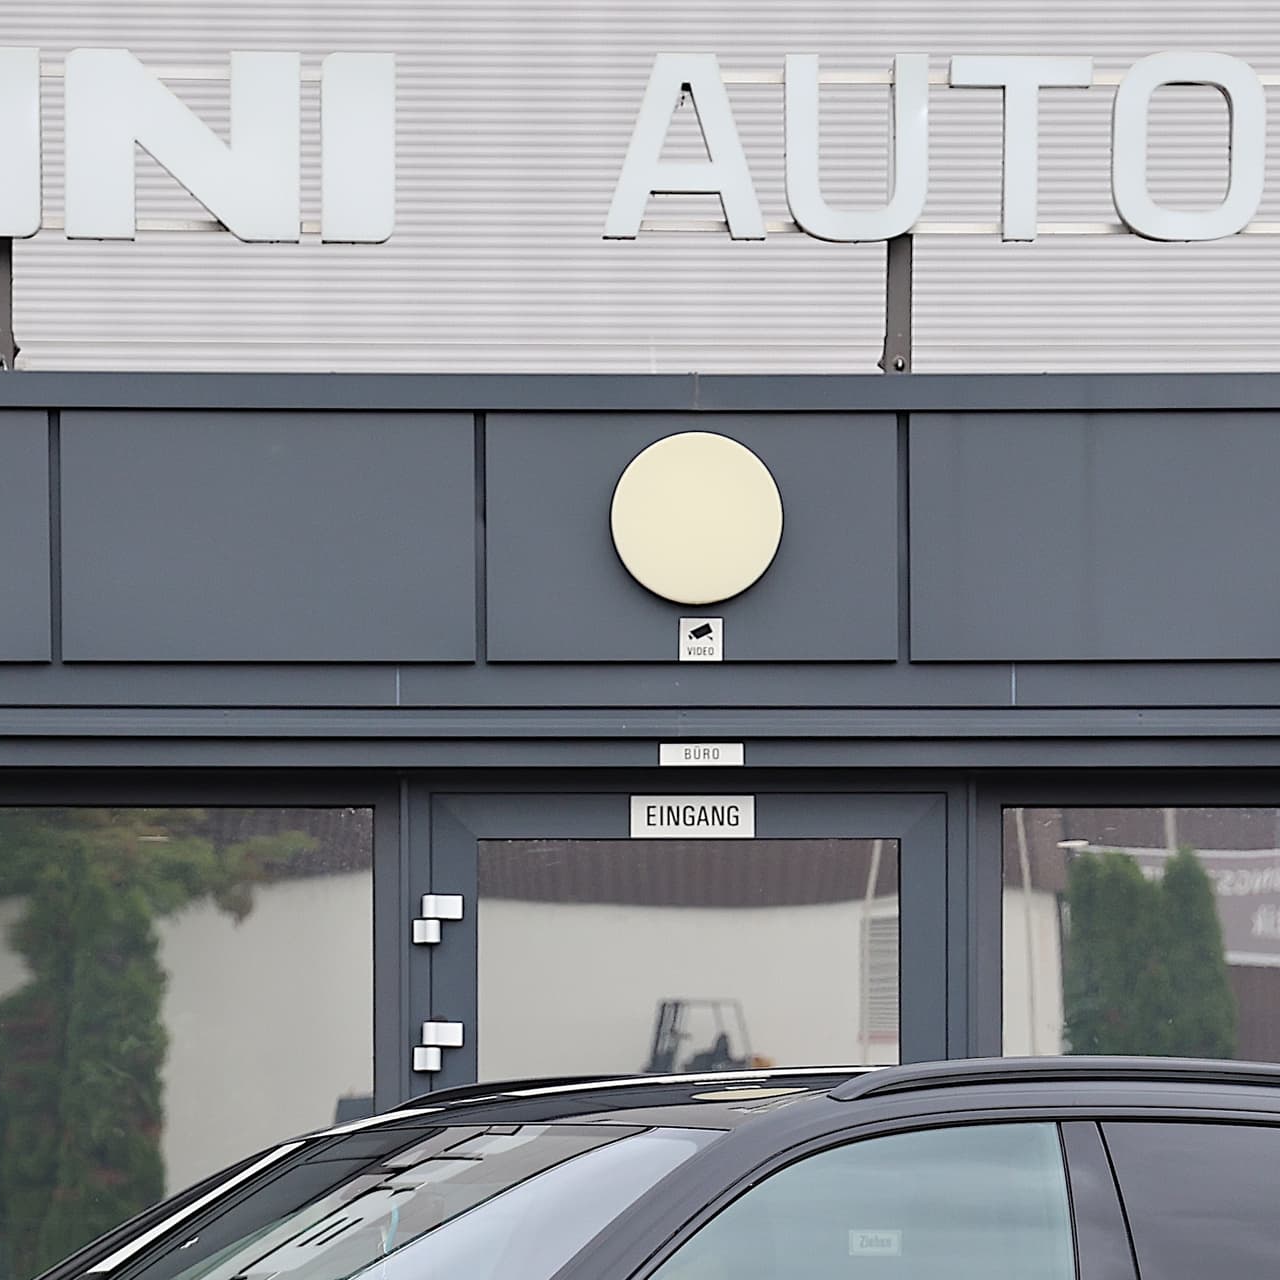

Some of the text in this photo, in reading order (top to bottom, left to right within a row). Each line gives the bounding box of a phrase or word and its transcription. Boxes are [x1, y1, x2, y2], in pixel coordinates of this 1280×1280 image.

[602, 50, 1267, 243] AUTO
[686, 645, 715, 657] VIDEO
[683, 745, 721, 761] BÜRO
[646, 804, 740, 828] EINGANG
